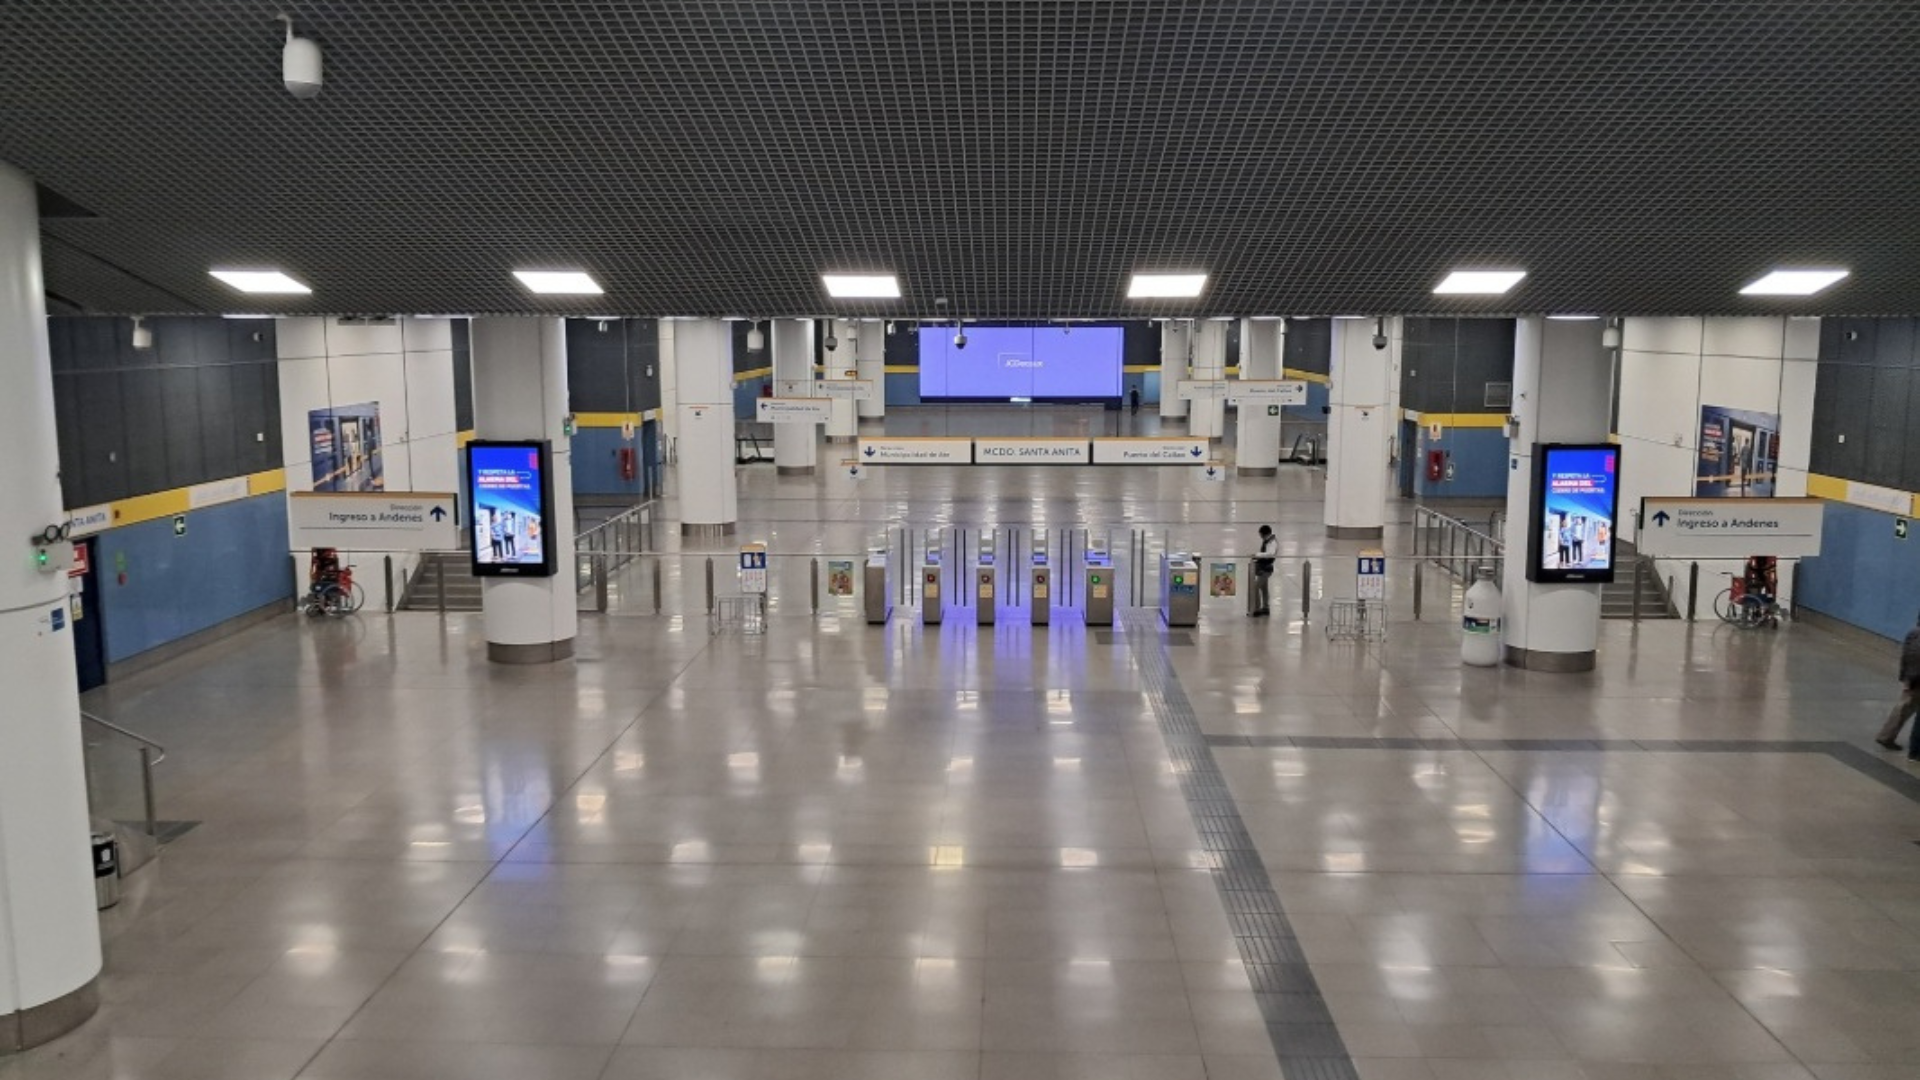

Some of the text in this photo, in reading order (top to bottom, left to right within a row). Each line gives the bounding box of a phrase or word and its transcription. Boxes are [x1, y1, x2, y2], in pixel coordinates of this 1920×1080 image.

[1019, 447, 1050, 456] SANTA
[1051, 447, 1081, 456] ANITA
[329, 512, 368, 524] Ingreso
[380, 512, 423, 523] Andenes
[1677, 518, 1779, 530] Ingreso a Andenes
